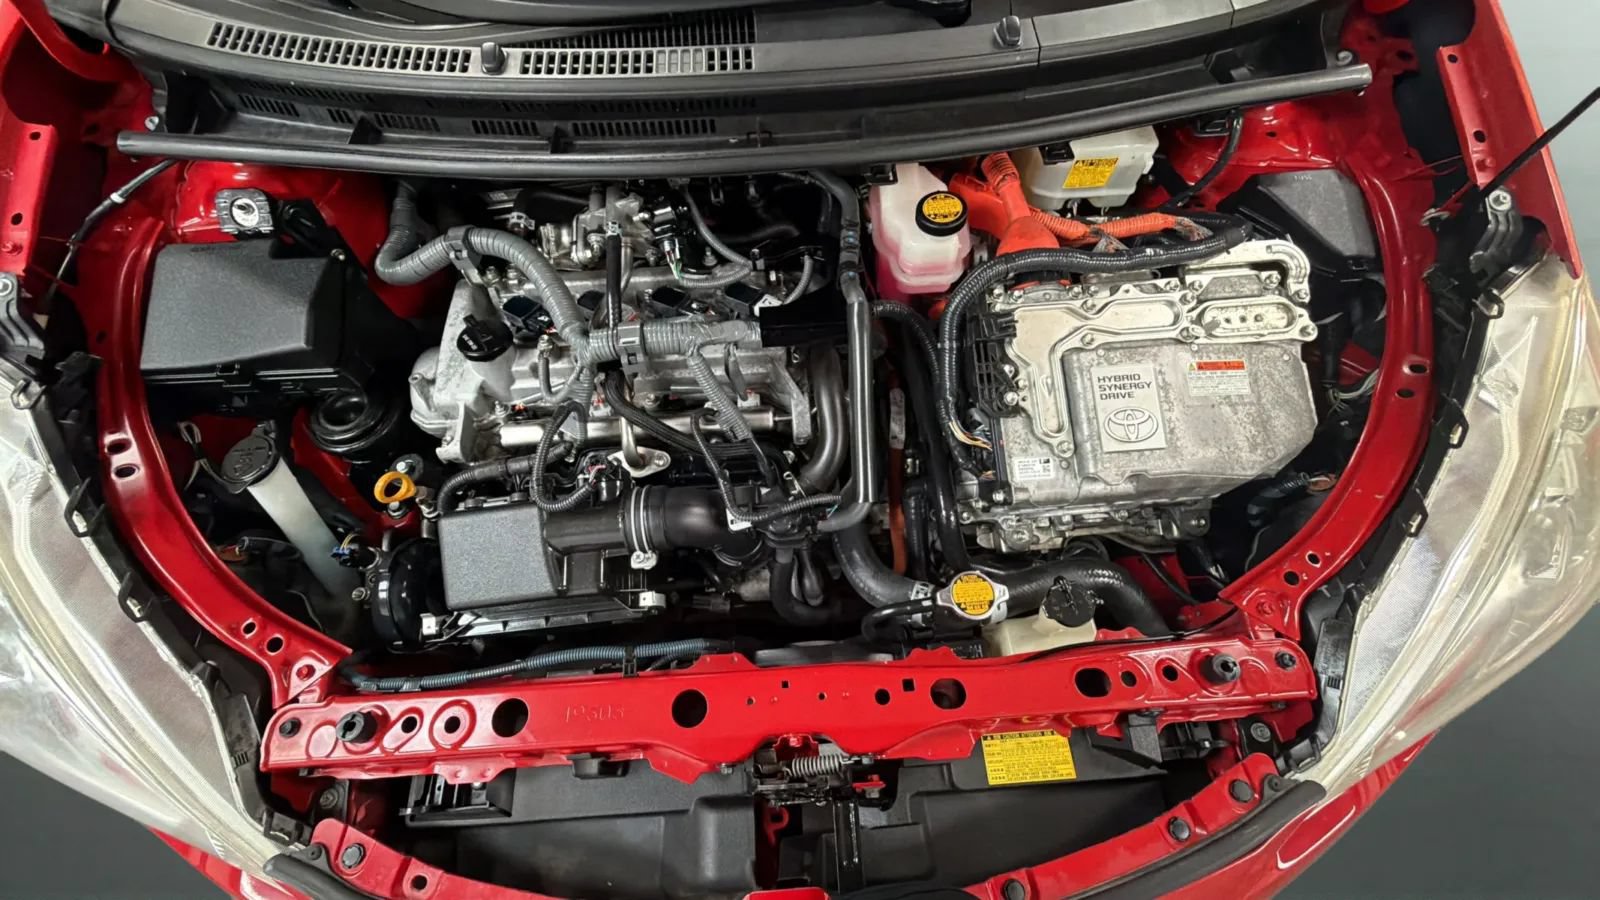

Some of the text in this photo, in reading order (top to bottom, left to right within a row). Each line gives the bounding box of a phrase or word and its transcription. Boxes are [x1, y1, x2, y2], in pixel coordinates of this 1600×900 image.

[1097, 373, 1141, 383] HYBRID
[1098, 382, 1152, 392] SYNERGY
[1100, 391, 1135, 400] DRIVE
